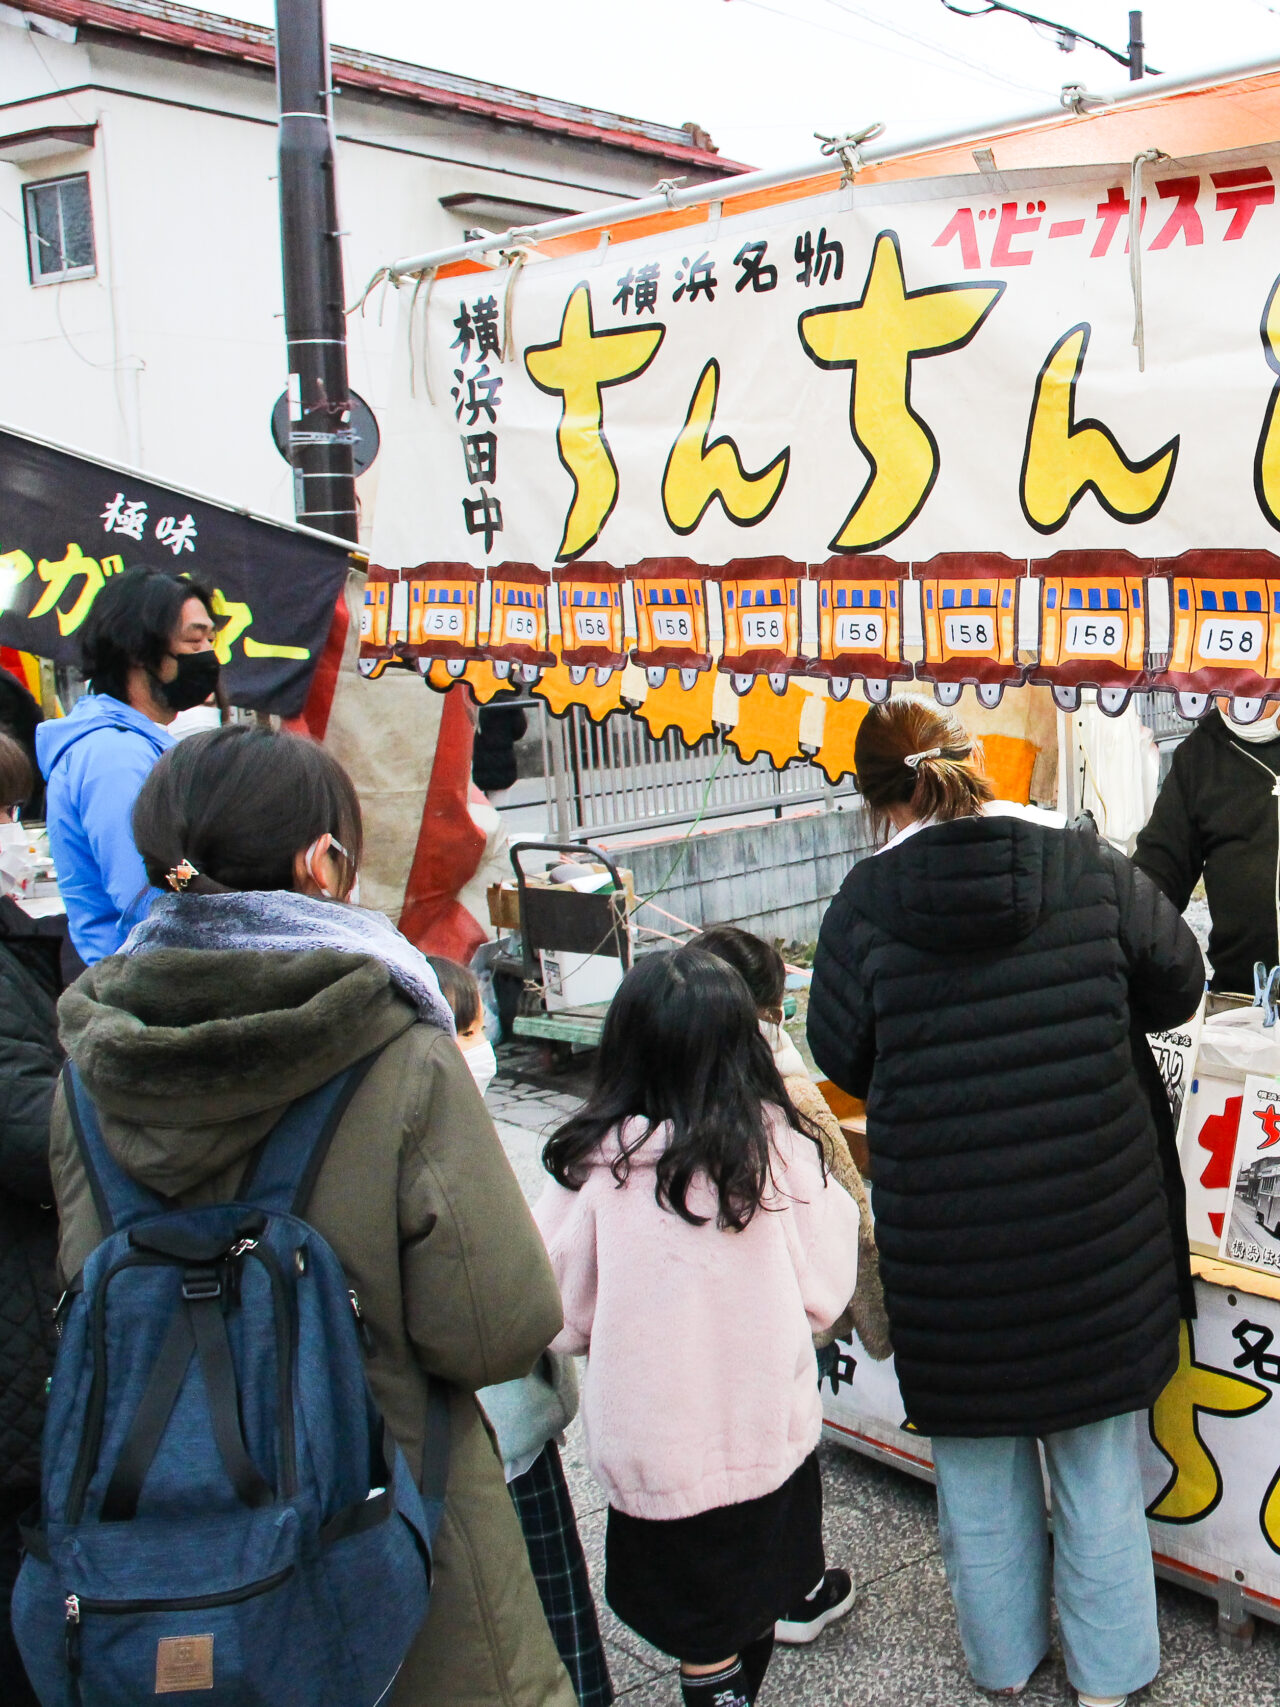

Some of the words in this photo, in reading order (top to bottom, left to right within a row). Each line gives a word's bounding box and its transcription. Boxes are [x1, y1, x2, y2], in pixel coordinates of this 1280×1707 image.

[612, 226, 844, 317] 横浜名物
[450, 294, 502, 555] 横浜田中
[100, 492, 198, 555] 極味
[426, 614, 459, 631] 158
[509, 617, 534, 634] 158
[578, 618, 606, 636] 158
[657, 617, 689, 636] 158
[745, 620, 780, 639] 158
[841, 621, 878, 643] 158
[949, 622, 988, 645] 158
[1072, 622, 1116, 647] 158
[1206, 627, 1255, 654] 158
